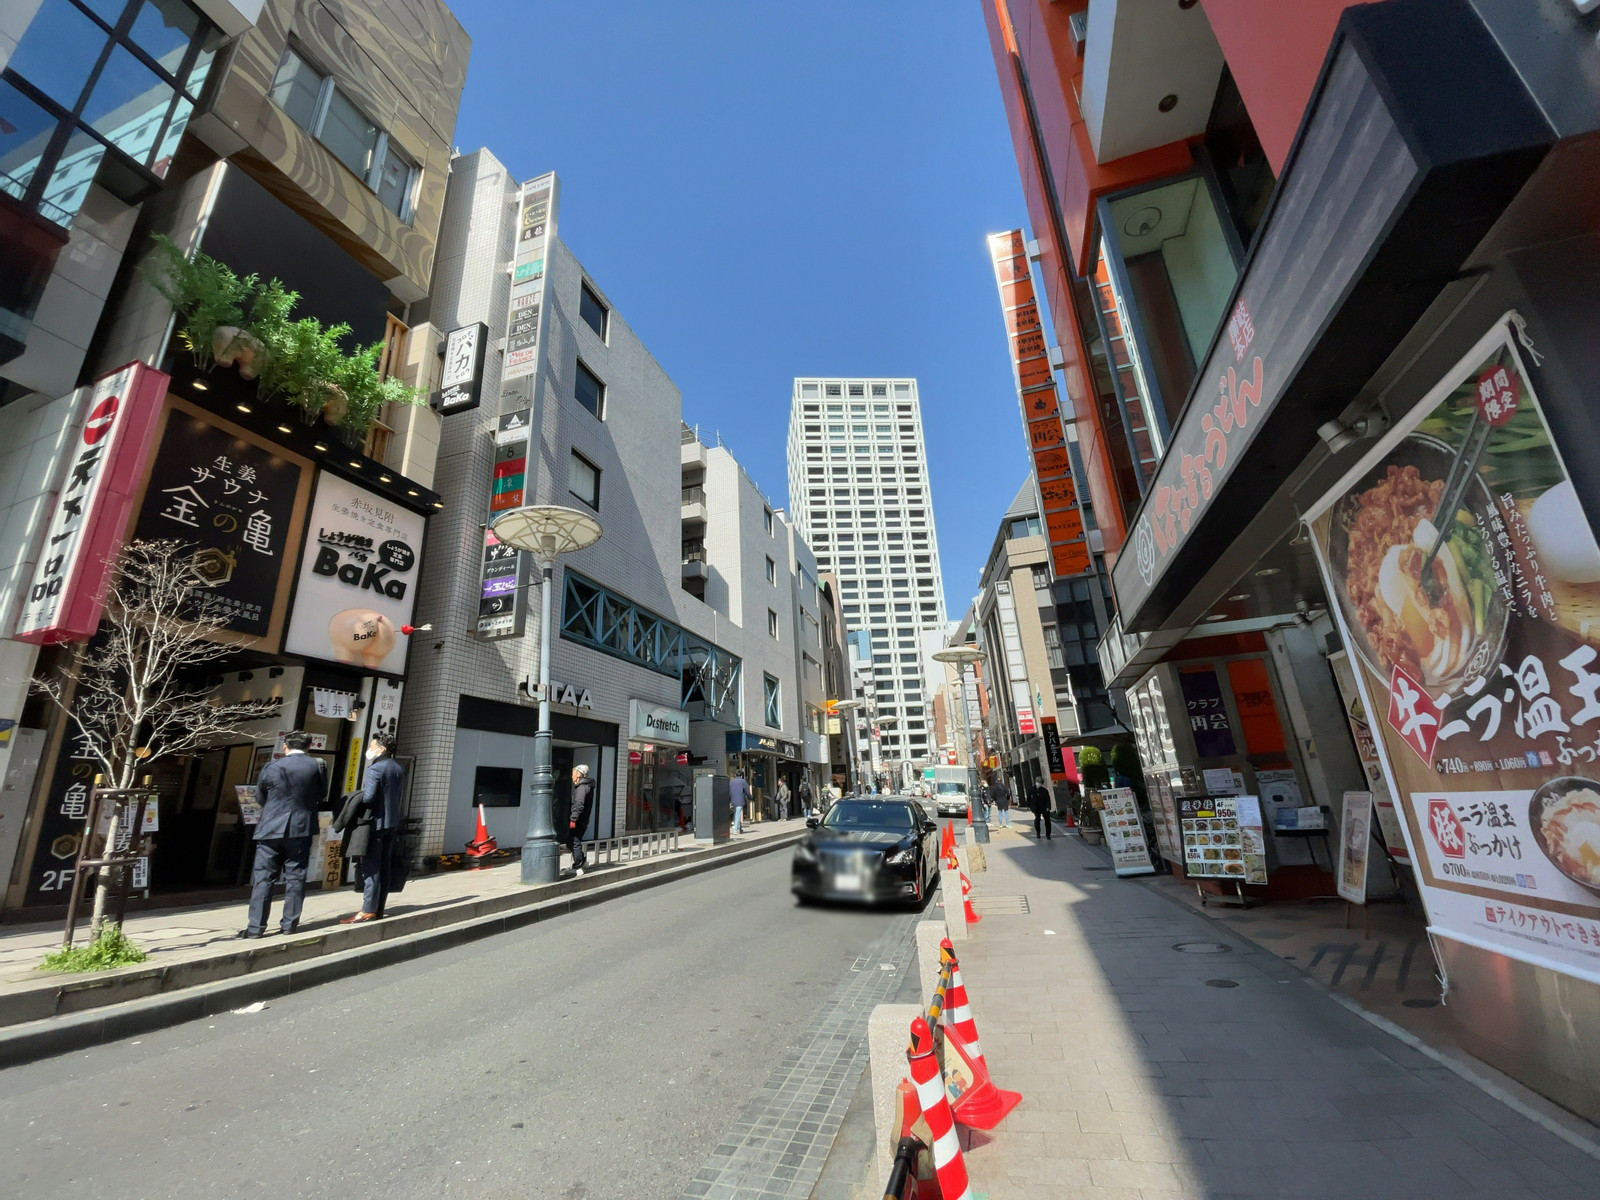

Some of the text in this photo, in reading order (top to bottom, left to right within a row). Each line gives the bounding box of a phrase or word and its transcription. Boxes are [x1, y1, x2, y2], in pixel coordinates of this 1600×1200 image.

[443, 392, 470, 406] BaKa
[1478, 368, 1510, 402] 期間
[1484, 391, 1517, 422] 限定
[213, 456, 257, 484] 生姜
[1151, 357, 1263, 556] はなまるうどん
[191, 466, 269, 504] サウナ
[160, 485, 274, 556] 金の亀
[352, 498, 395, 524] 赤坂見附
[312, 546, 407, 601] BaKa
[1475, 512, 1524, 618] とろける温玉で。
[1485, 501, 1539, 619] 風味豊かなニラを
[1501, 493, 1558, 622] 旨みたっぷり牛肉と
[1188, 697, 1220, 709] クラブ
[1392, 677, 1438, 752] 牛
[1190, 714, 1229, 731] 再会
[1047, 731, 1060, 763] アパホテル
[1556, 729, 1600, 766] ぶっ
[1217, 808, 1237, 818] 950円
[1432, 801, 1517, 849] 豚 ニラ温玉
[1466, 832, 1523, 860] ぶっかけ
[40, 869, 76, 891] 2F
